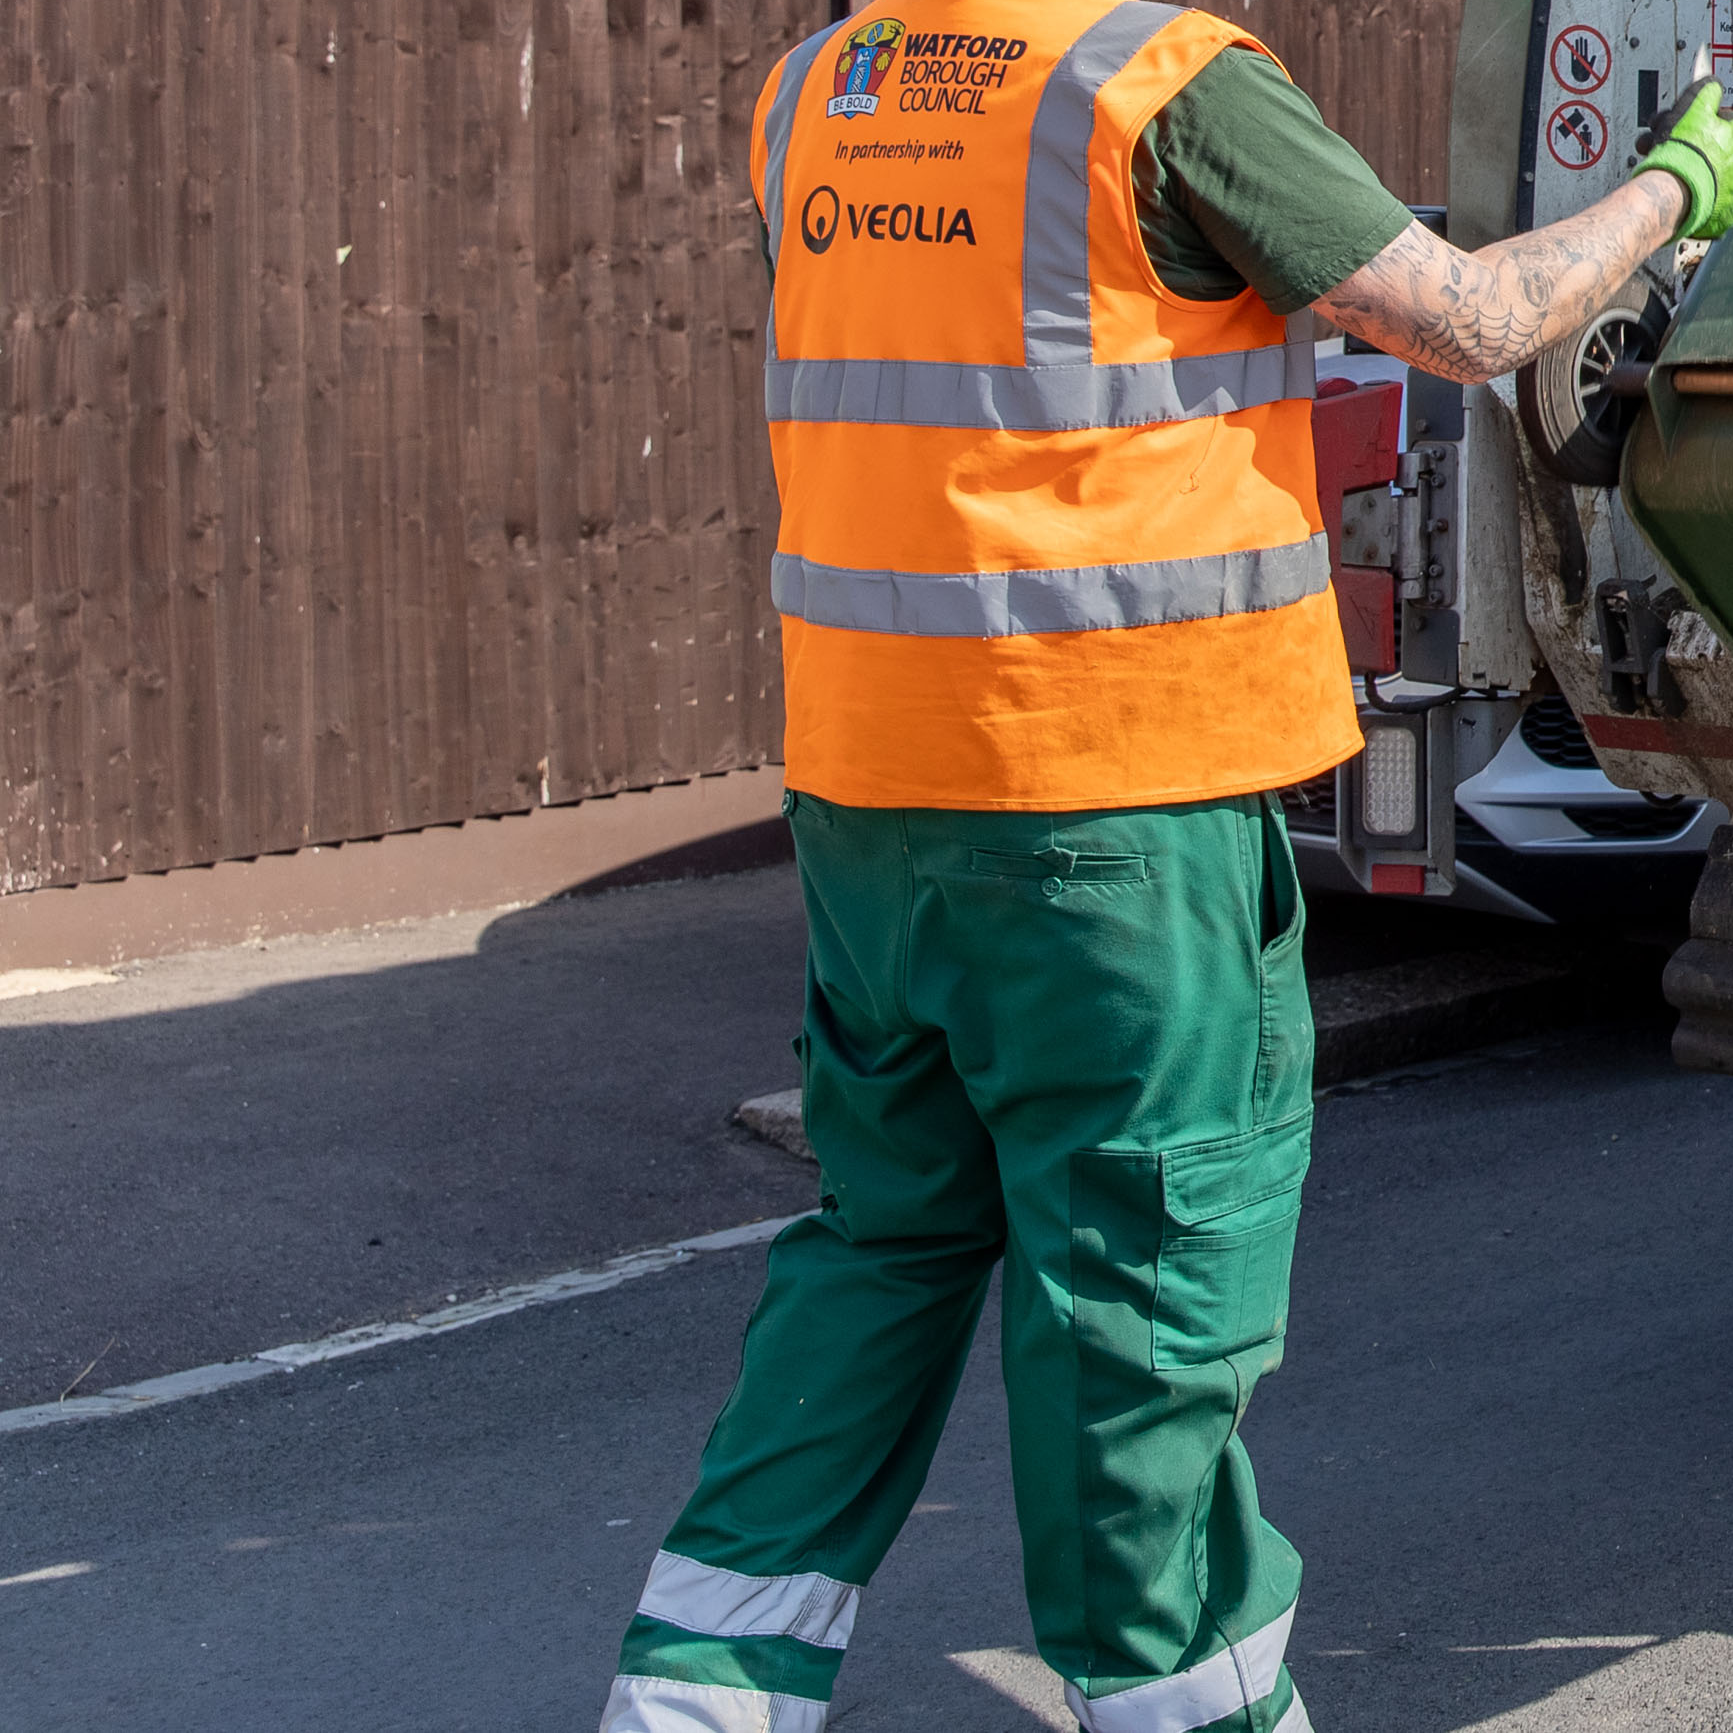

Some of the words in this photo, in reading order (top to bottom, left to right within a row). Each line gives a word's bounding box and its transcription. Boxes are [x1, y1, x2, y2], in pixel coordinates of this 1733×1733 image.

[904, 33, 1027, 61] WATFORD
[900, 61, 1008, 89] BOROUGH
[833, 98, 846, 112] BE
[847, 95, 873, 111] BOLD
[899, 87, 986, 115] COUNCIL
[835, 140, 848, 159] In
[849, 140, 925, 165] partnership
[928, 143, 964, 161] with
[847, 203, 977, 246] VEOLIA
